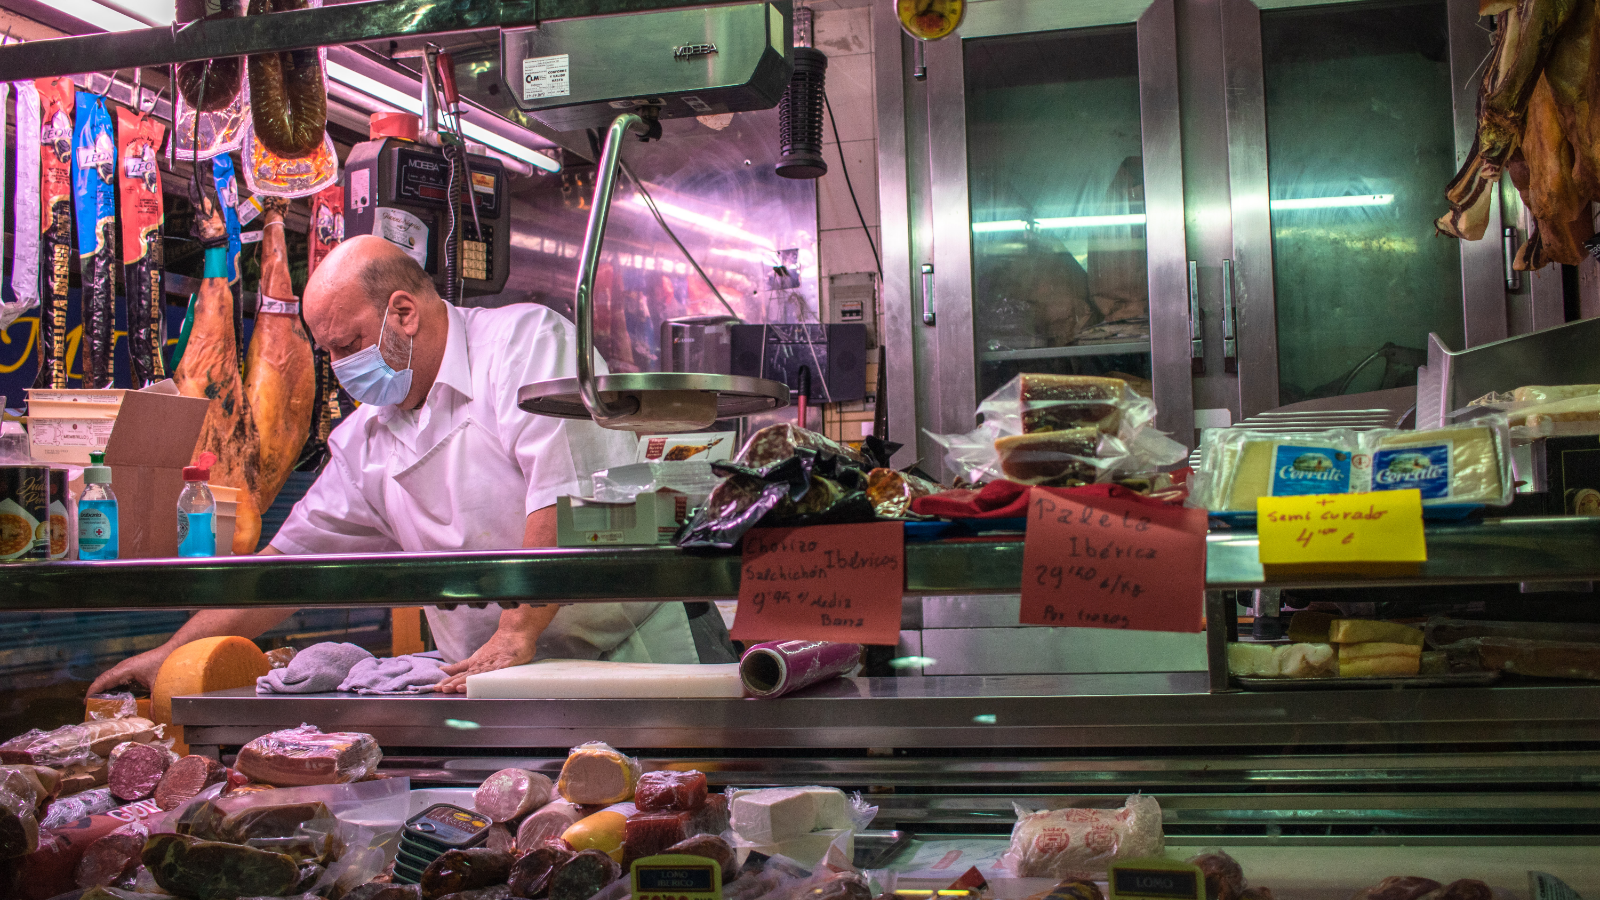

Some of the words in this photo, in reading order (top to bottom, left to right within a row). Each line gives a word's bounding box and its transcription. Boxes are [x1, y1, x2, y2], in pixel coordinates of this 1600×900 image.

[525, 74, 540, 84] CLM
[1036, 497, 1152, 531] Paleta
[749, 538, 818, 553] Chorizo
[1069, 536, 1157, 559] Ibérica
[661, 871, 689, 879] LOMO
[1136, 877, 1174, 889] LOMO
